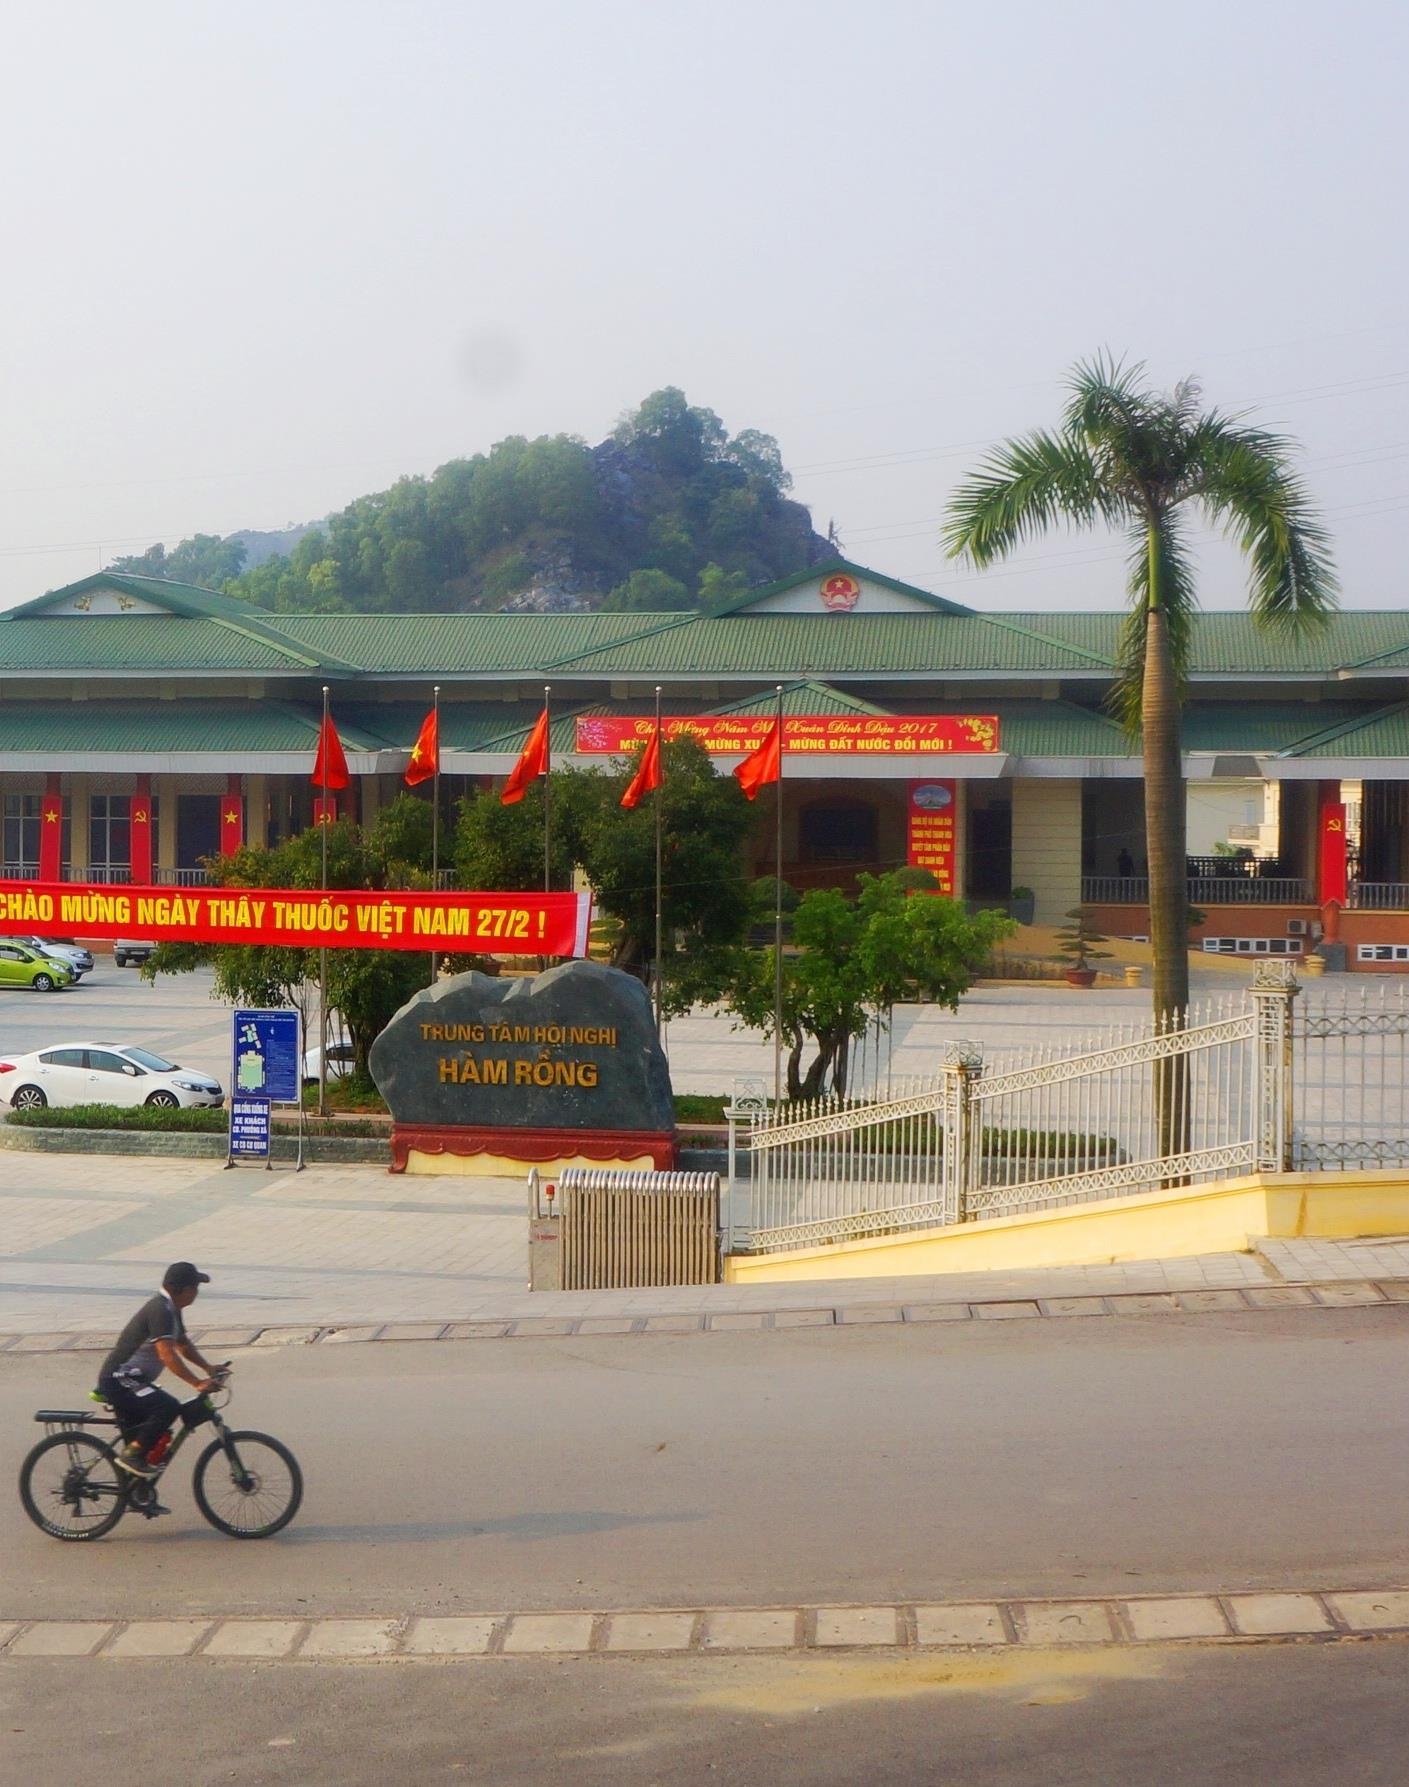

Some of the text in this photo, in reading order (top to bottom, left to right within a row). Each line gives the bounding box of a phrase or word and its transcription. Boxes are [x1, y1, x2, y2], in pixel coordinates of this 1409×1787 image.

[897, 722, 938, 734] 2017
[61, 889, 131, 924] MỪNG
[137, 893, 201, 926] NGÀY
[272, 895, 349, 932] THUỐC
[356, 900, 407, 939] VIỆT
[413, 907, 470, 936] NAM
[476, 909, 530, 938] 27/2
[538, 911, 546, 938] !
[420, 1023, 485, 1042] TRUNG
[489, 1021, 530, 1042] TÂM
[571, 1026, 617, 1048] NGHỊ
[439, 1049, 598, 1088] HÀM RỒNG
